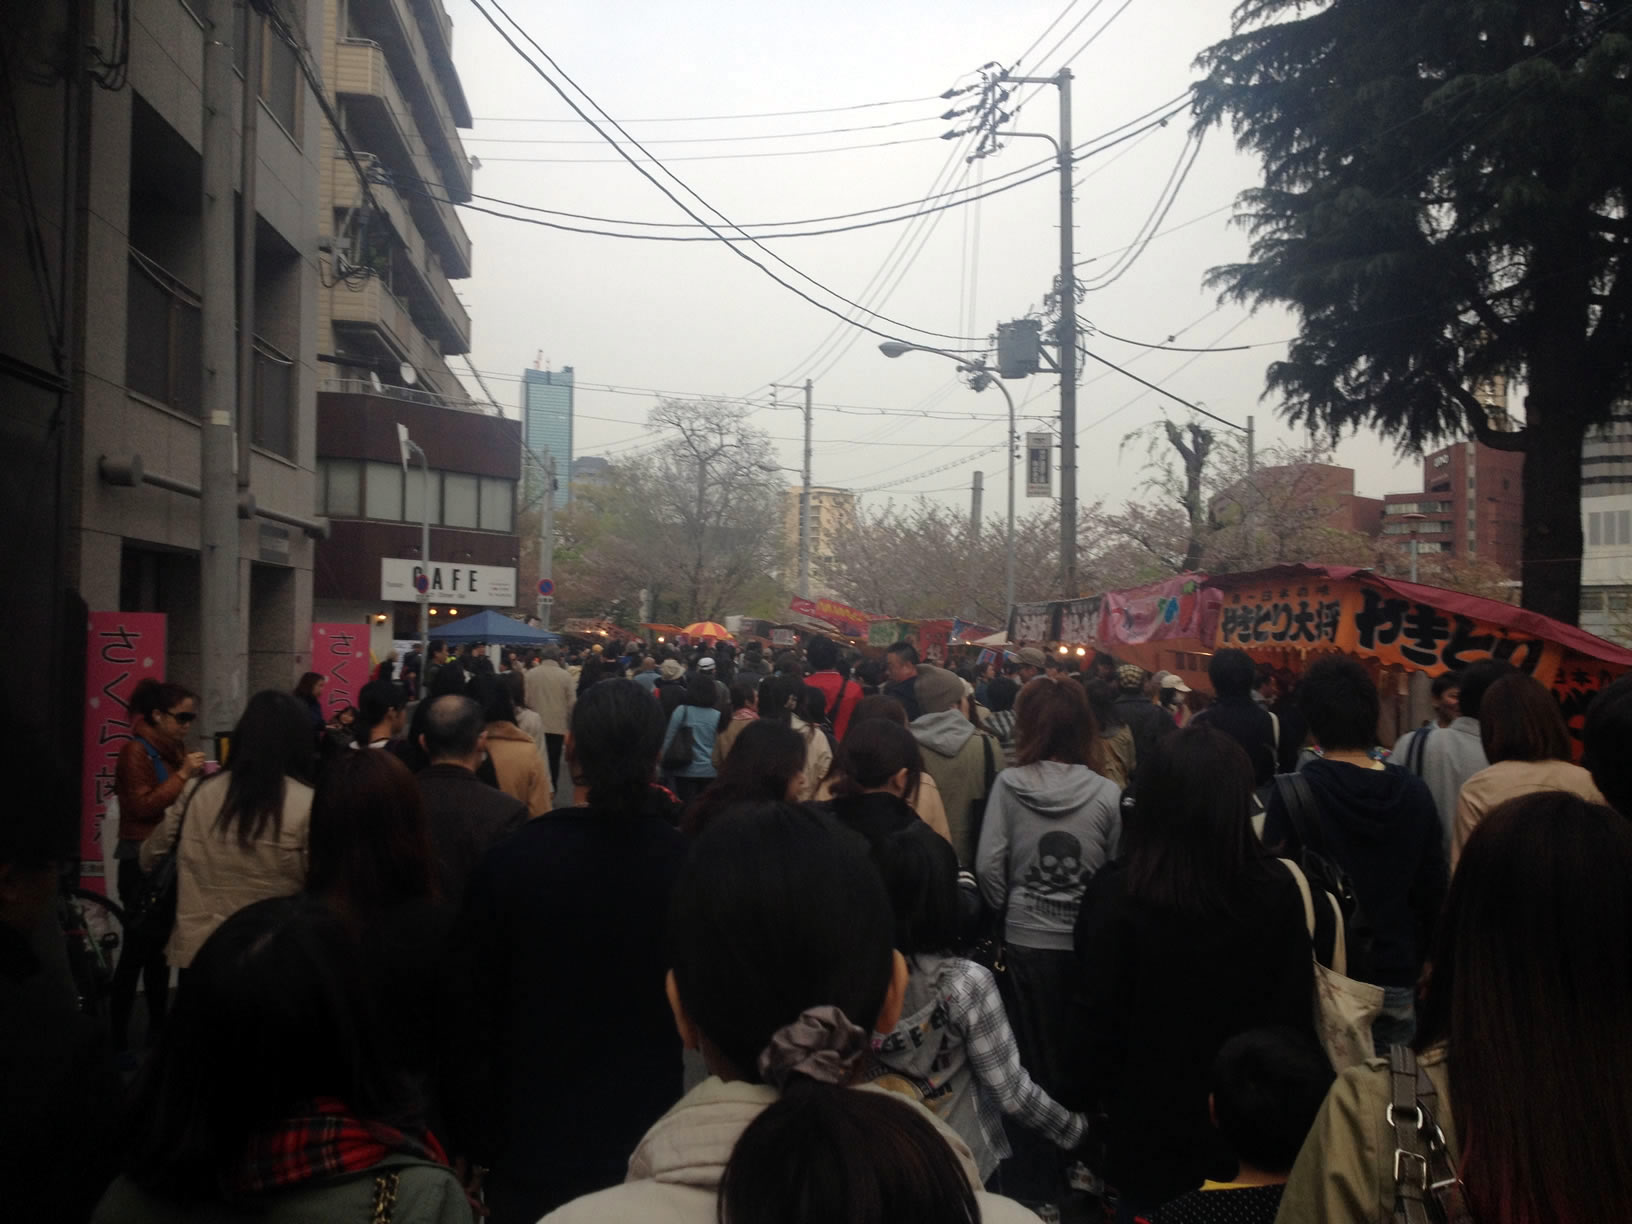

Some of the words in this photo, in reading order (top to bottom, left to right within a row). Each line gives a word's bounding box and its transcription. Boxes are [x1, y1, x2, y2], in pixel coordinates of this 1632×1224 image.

[1222, 601, 1339, 643] やきとり大将
[1356, 588, 1544, 677] やきとり
